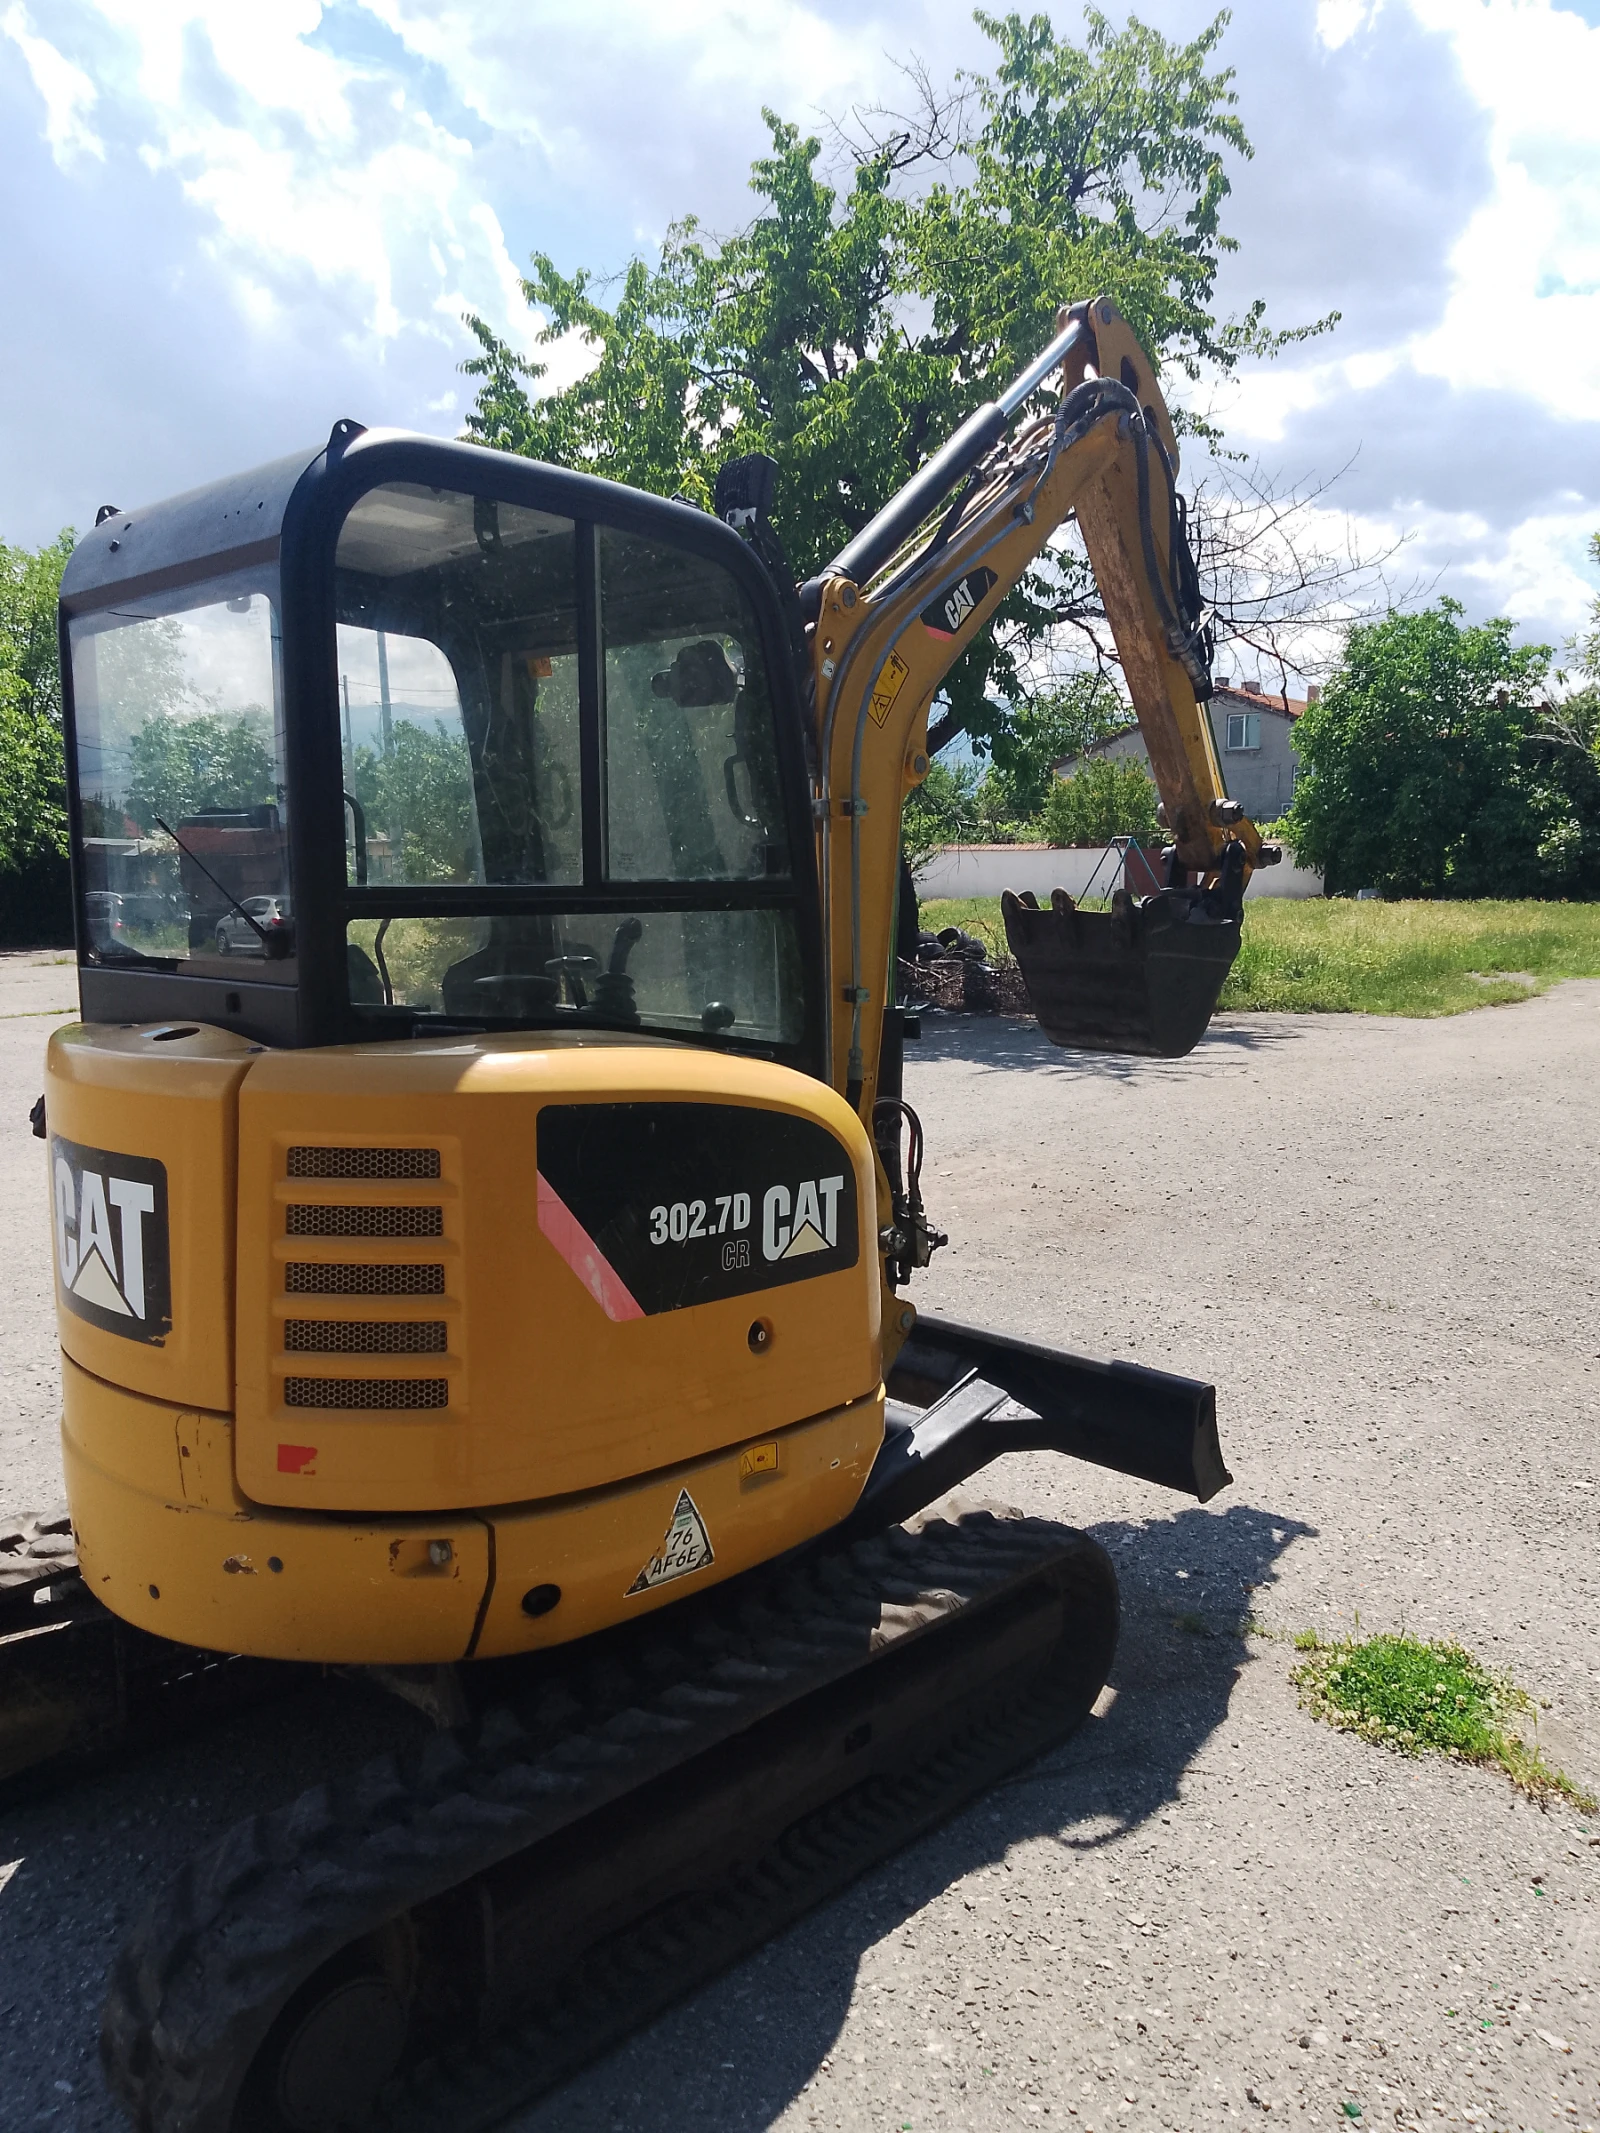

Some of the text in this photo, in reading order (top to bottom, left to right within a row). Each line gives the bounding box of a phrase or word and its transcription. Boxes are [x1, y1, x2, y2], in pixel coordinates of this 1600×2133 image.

[944, 578, 975, 629] CAT
[55, 1157, 155, 1320] CAT
[650, 1193, 751, 1245] 302.7D
[763, 1175, 844, 1261] CAT
[721, 1240, 750, 1271] CR
[650, 1545, 700, 1578] AF6E
[671, 1527, 693, 1550] 76
